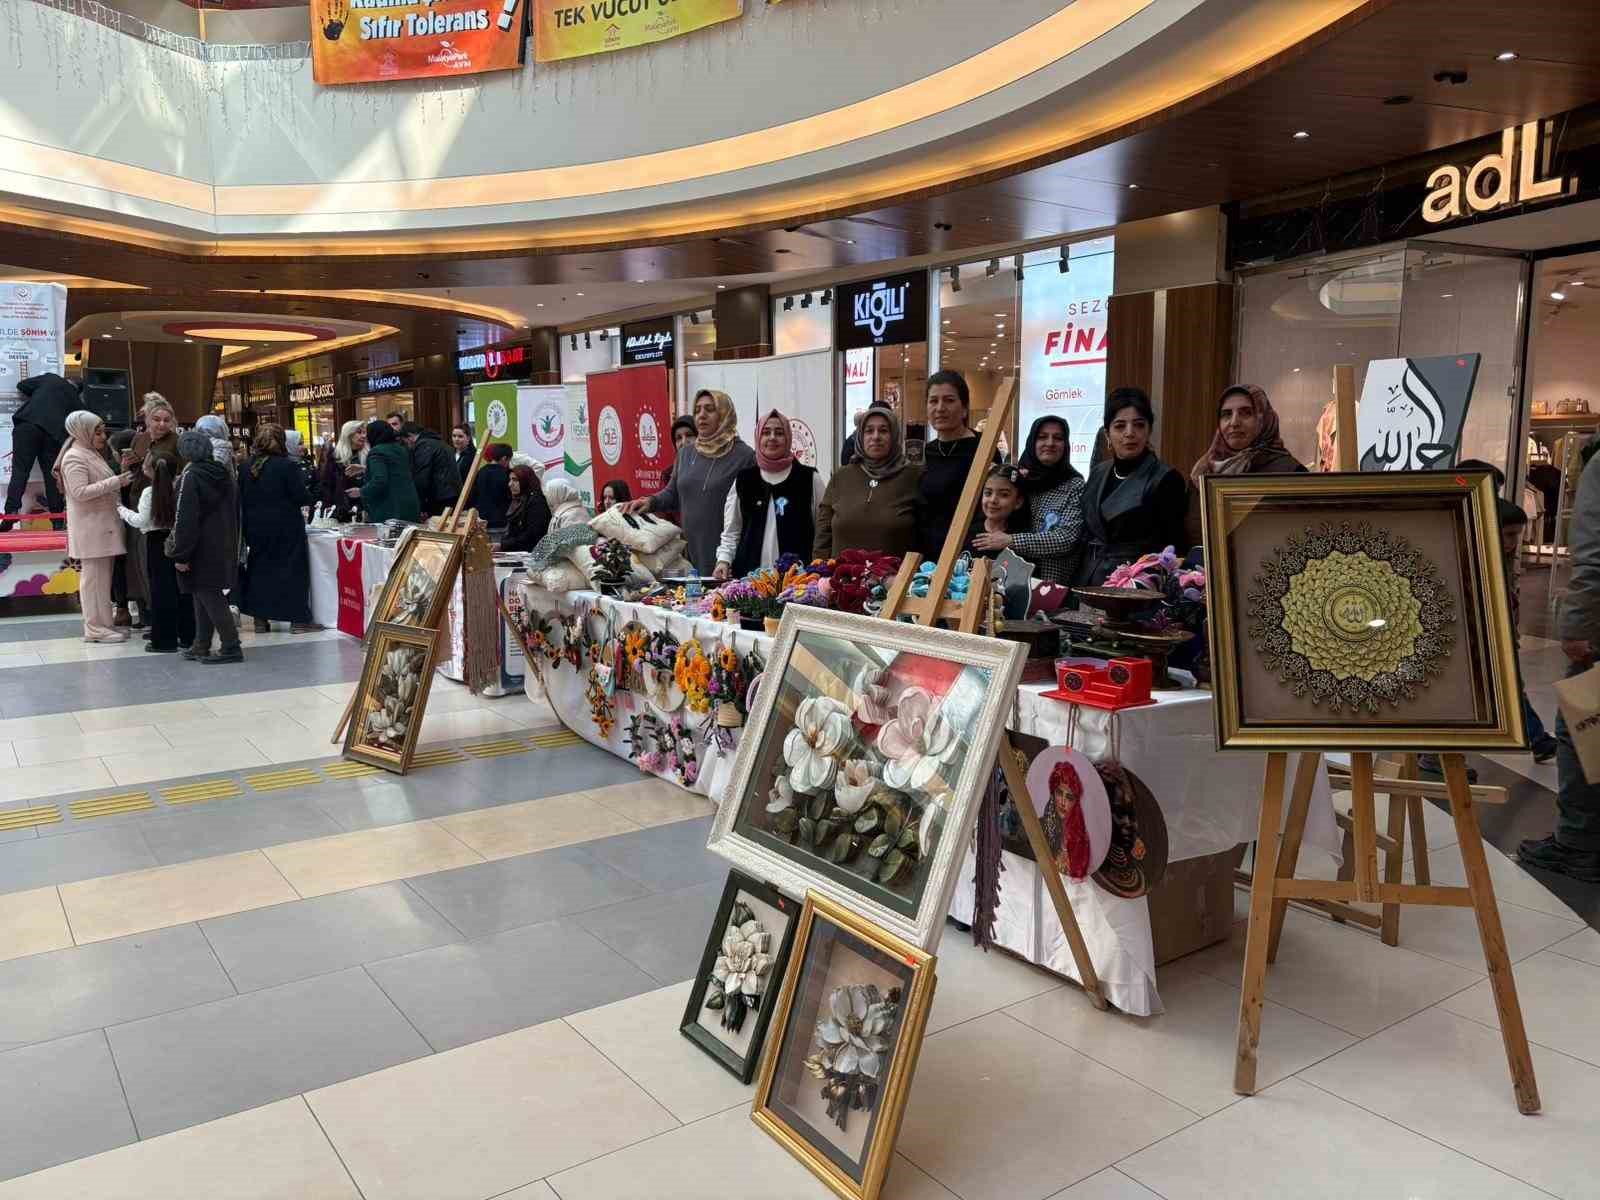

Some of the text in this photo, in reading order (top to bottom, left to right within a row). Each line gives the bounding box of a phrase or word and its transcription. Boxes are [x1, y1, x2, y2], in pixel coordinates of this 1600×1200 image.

[405, 9, 489, 37] Tolerans
[554, 6, 585, 28] TEK
[375, 376, 401, 388] KARACA
[1045, 389, 1082, 401] Gömlek
